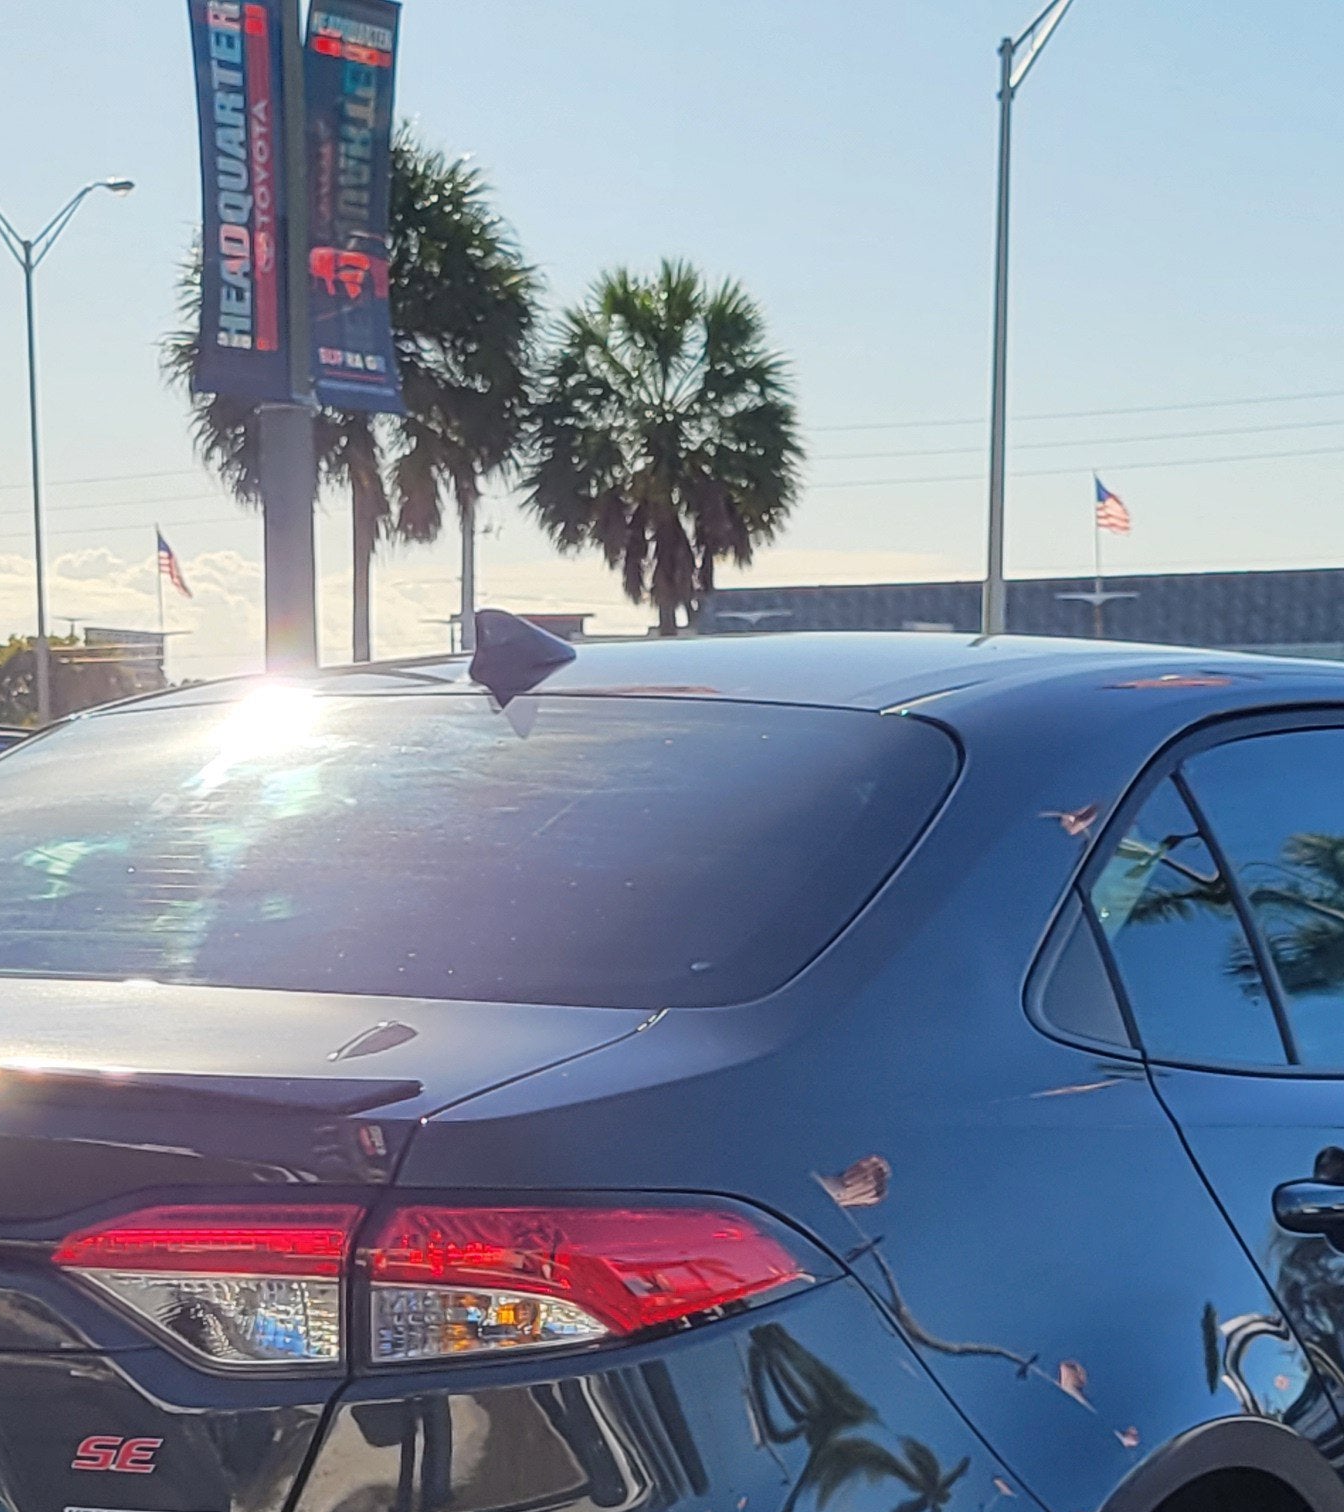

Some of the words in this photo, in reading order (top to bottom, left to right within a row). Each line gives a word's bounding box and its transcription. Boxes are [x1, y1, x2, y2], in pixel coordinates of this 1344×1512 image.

[207, 1, 253, 349] HEADQUARTER
[253, 101, 271, 229] TOYOTA
[71, 1435, 164, 1474] SE
